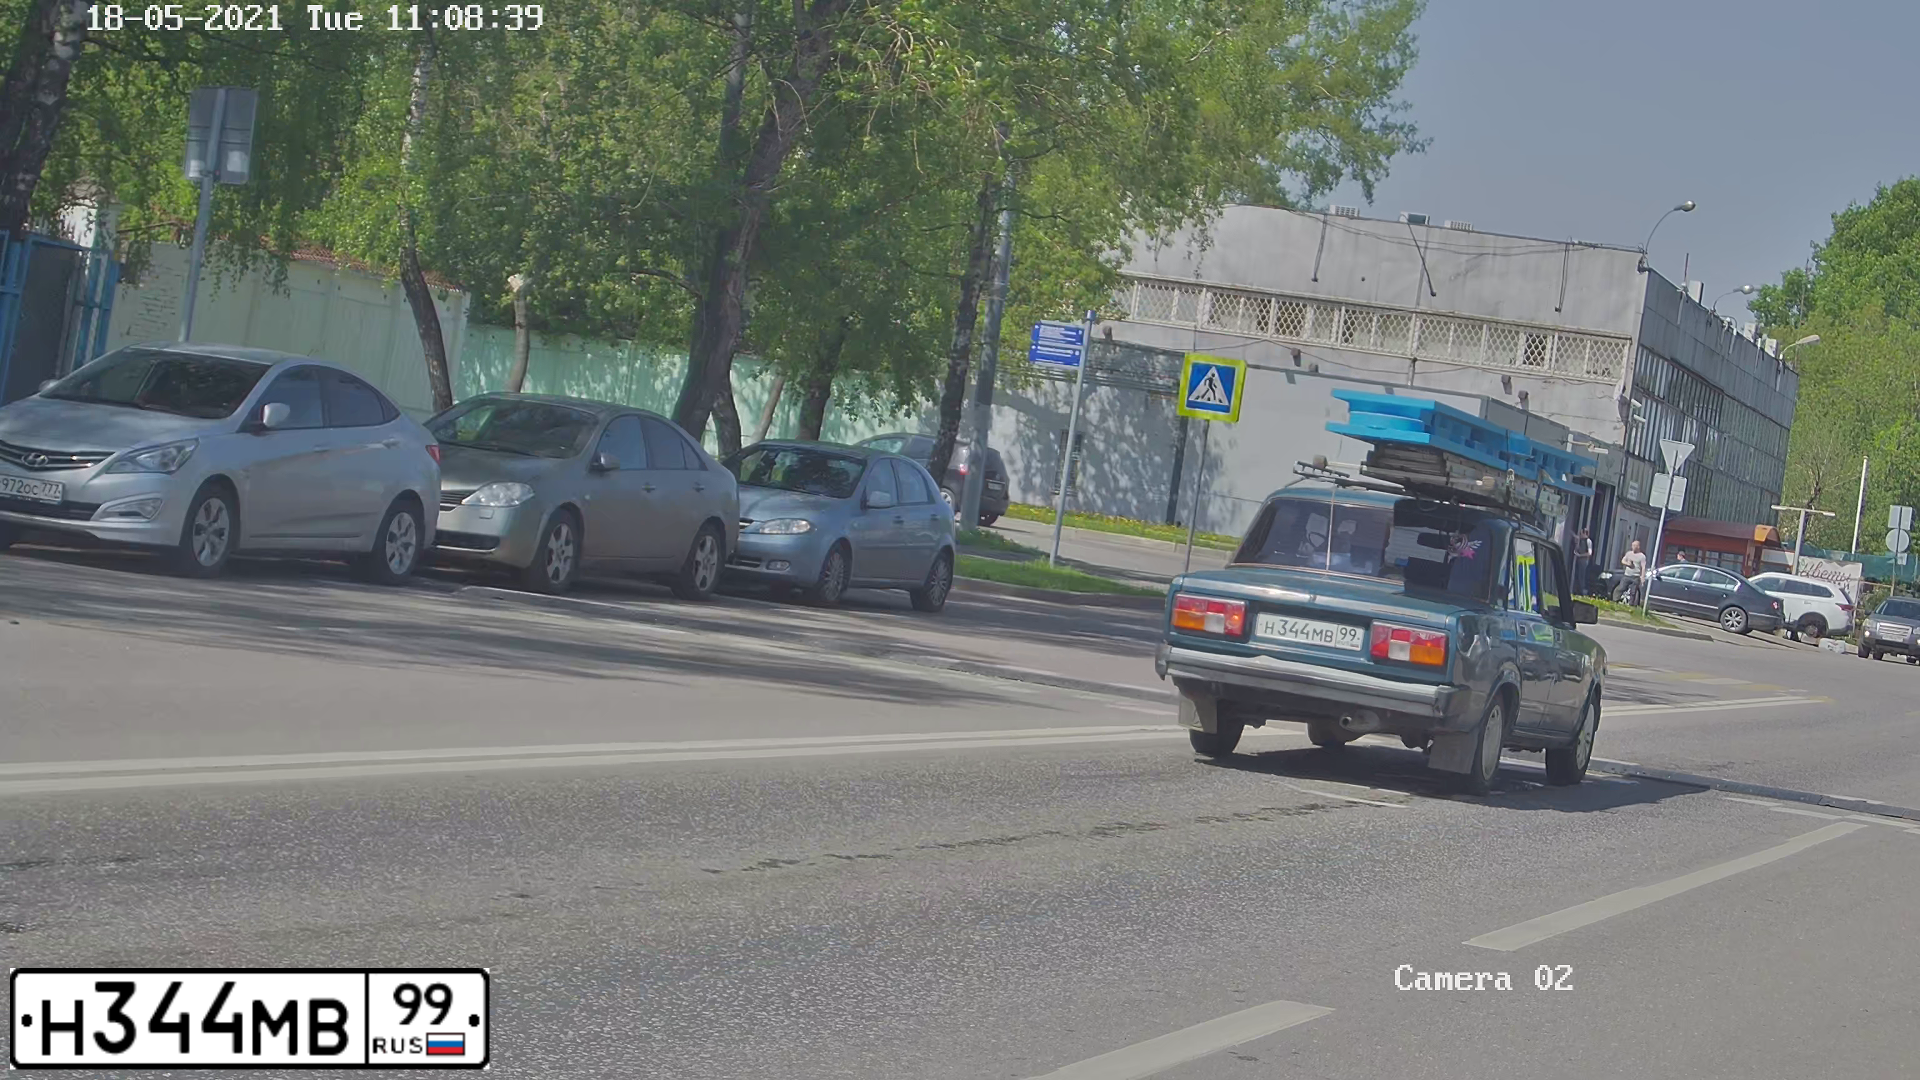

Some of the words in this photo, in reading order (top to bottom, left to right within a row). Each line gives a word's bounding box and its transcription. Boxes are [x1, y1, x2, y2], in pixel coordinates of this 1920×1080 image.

[0, 477, 38, 496] 972ОС
[42, 482, 60, 495] 777
[1264, 619, 1334, 643] Н344МВ
[1340, 627, 1357, 641] 99
